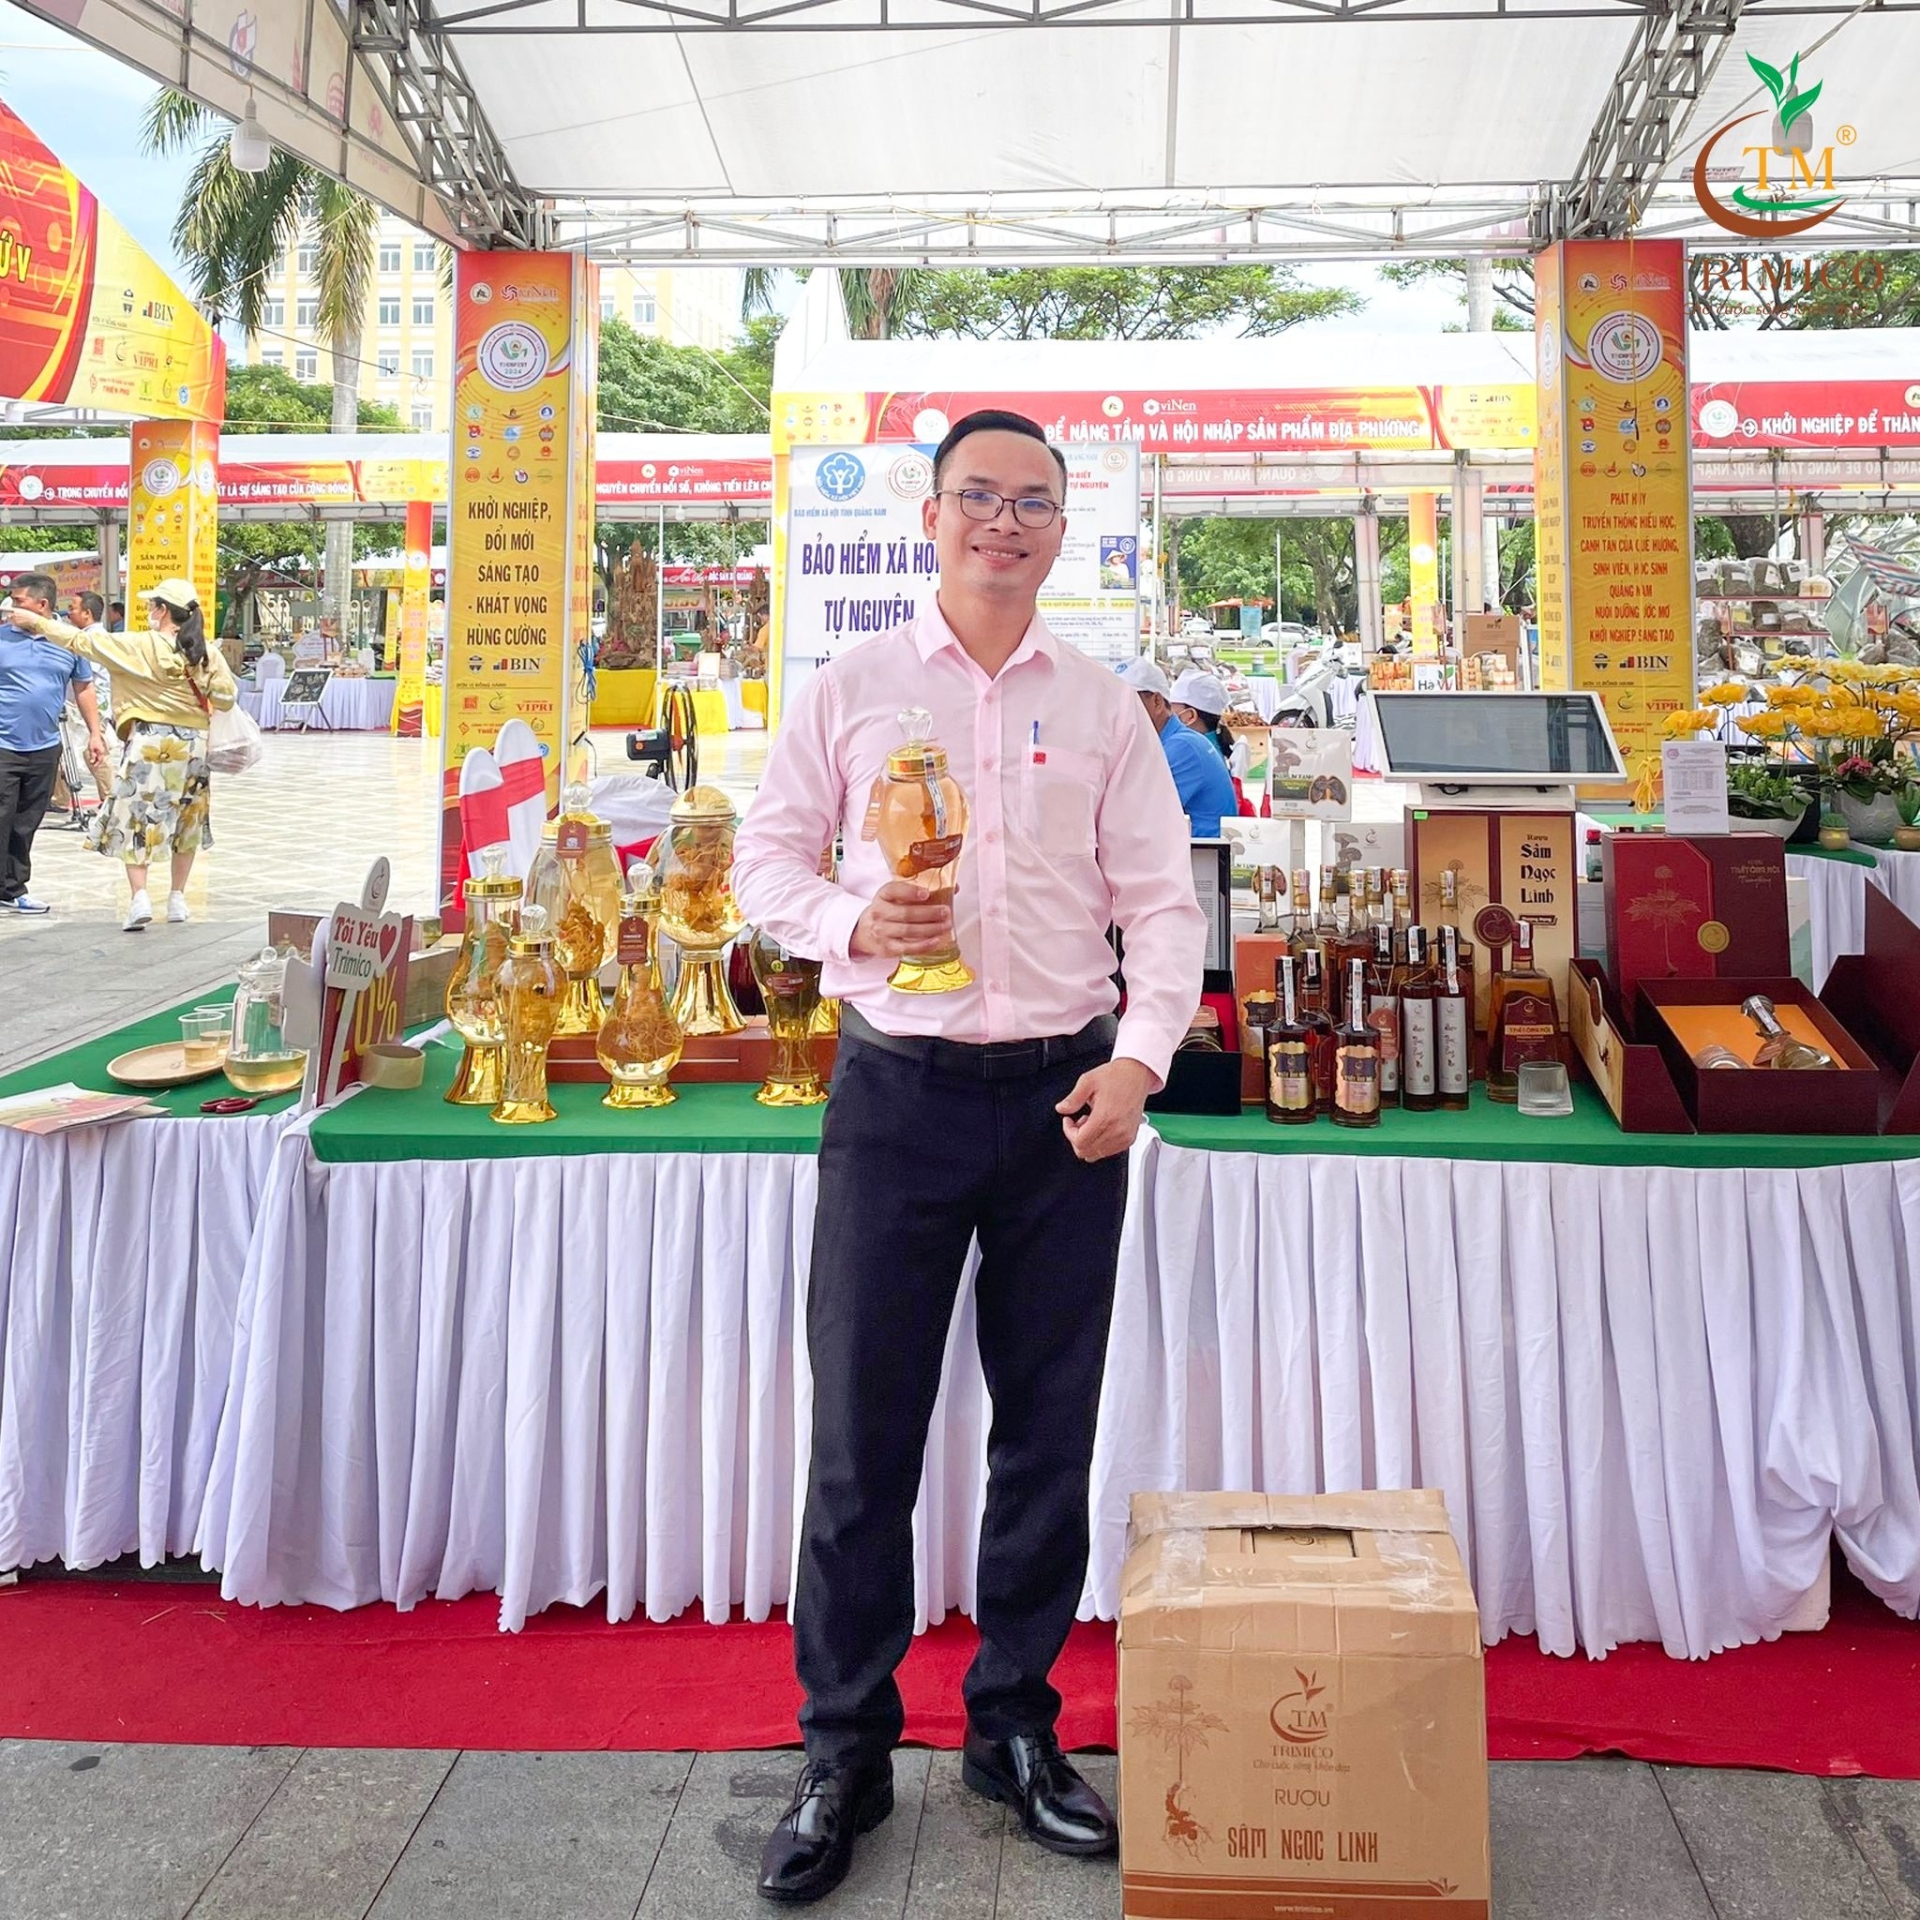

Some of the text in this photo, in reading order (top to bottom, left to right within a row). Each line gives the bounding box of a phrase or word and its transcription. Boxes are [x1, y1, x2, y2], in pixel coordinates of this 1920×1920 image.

[1160, 398, 1197, 412] viNen
[1045, 413, 1420, 444] ĐỂ NÂNG TẦM VÀ HỘI NHẬP SẢN PHẨM ĐỊA PHƯƠNG
[1762, 408, 1920, 437] KHỞI NGHIỆP ĐỂ THÀN
[1076, 470, 1092, 479] BIẾT
[57, 486, 83, 499] TRONG
[84, 481, 114, 498] CHUYỂN
[227, 483, 238, 496] LÀ
[239, 483, 250, 498] SỰ
[251, 482, 272, 497] SÁNG
[289, 479, 305, 495] CỦA
[629, 478, 662, 494] CHUYỂN
[663, 478, 677, 494] ĐỔI
[694, 480, 721, 493] KHÔNG
[723, 478, 742, 493] TIẾN
[743, 479, 760, 492] LÊN
[1610, 489, 1629, 505] PHÁT
[468, 495, 551, 522] KHỞI NGHIỆP,
[485, 524, 534, 551] ĐỔI MỚI
[1618, 534, 1633, 552] CỦA
[802, 532, 835, 576] BẢO
[840, 529, 881, 575] HIỂM
[886, 536, 908, 575] XÃ
[478, 561, 539, 585] SÁNG TẠO
[1593, 562, 1611, 576] SINH
[1651, 562, 1668, 576] SINH
[1609, 580, 1634, 599] QUẢNG
[476, 592, 547, 618] KHÁT VỌNG
[824, 596, 847, 640] TỰ
[467, 623, 547, 646] HÙNG CƯỜNG
[1589, 624, 1608, 642] KHỞI
[510, 657, 541, 671] BIN
[1637, 655, 1670, 670] BIN
[516, 703, 553, 712] VIPRI
[1646, 702, 1685, 711] VIPRI
[1520, 842, 1552, 859] Sâm
[1520, 864, 1557, 883] Ngọc
[1520, 887, 1554, 904] Linh
[333, 915, 379, 949] Tôi Yêu
[332, 946, 372, 978] Trimico
[1269, 1745, 1334, 1760] TRIMICO
[1274, 1788, 1331, 1811] RƯỢU
[1227, 1823, 1379, 1867] SÂM NGỌC LINH
